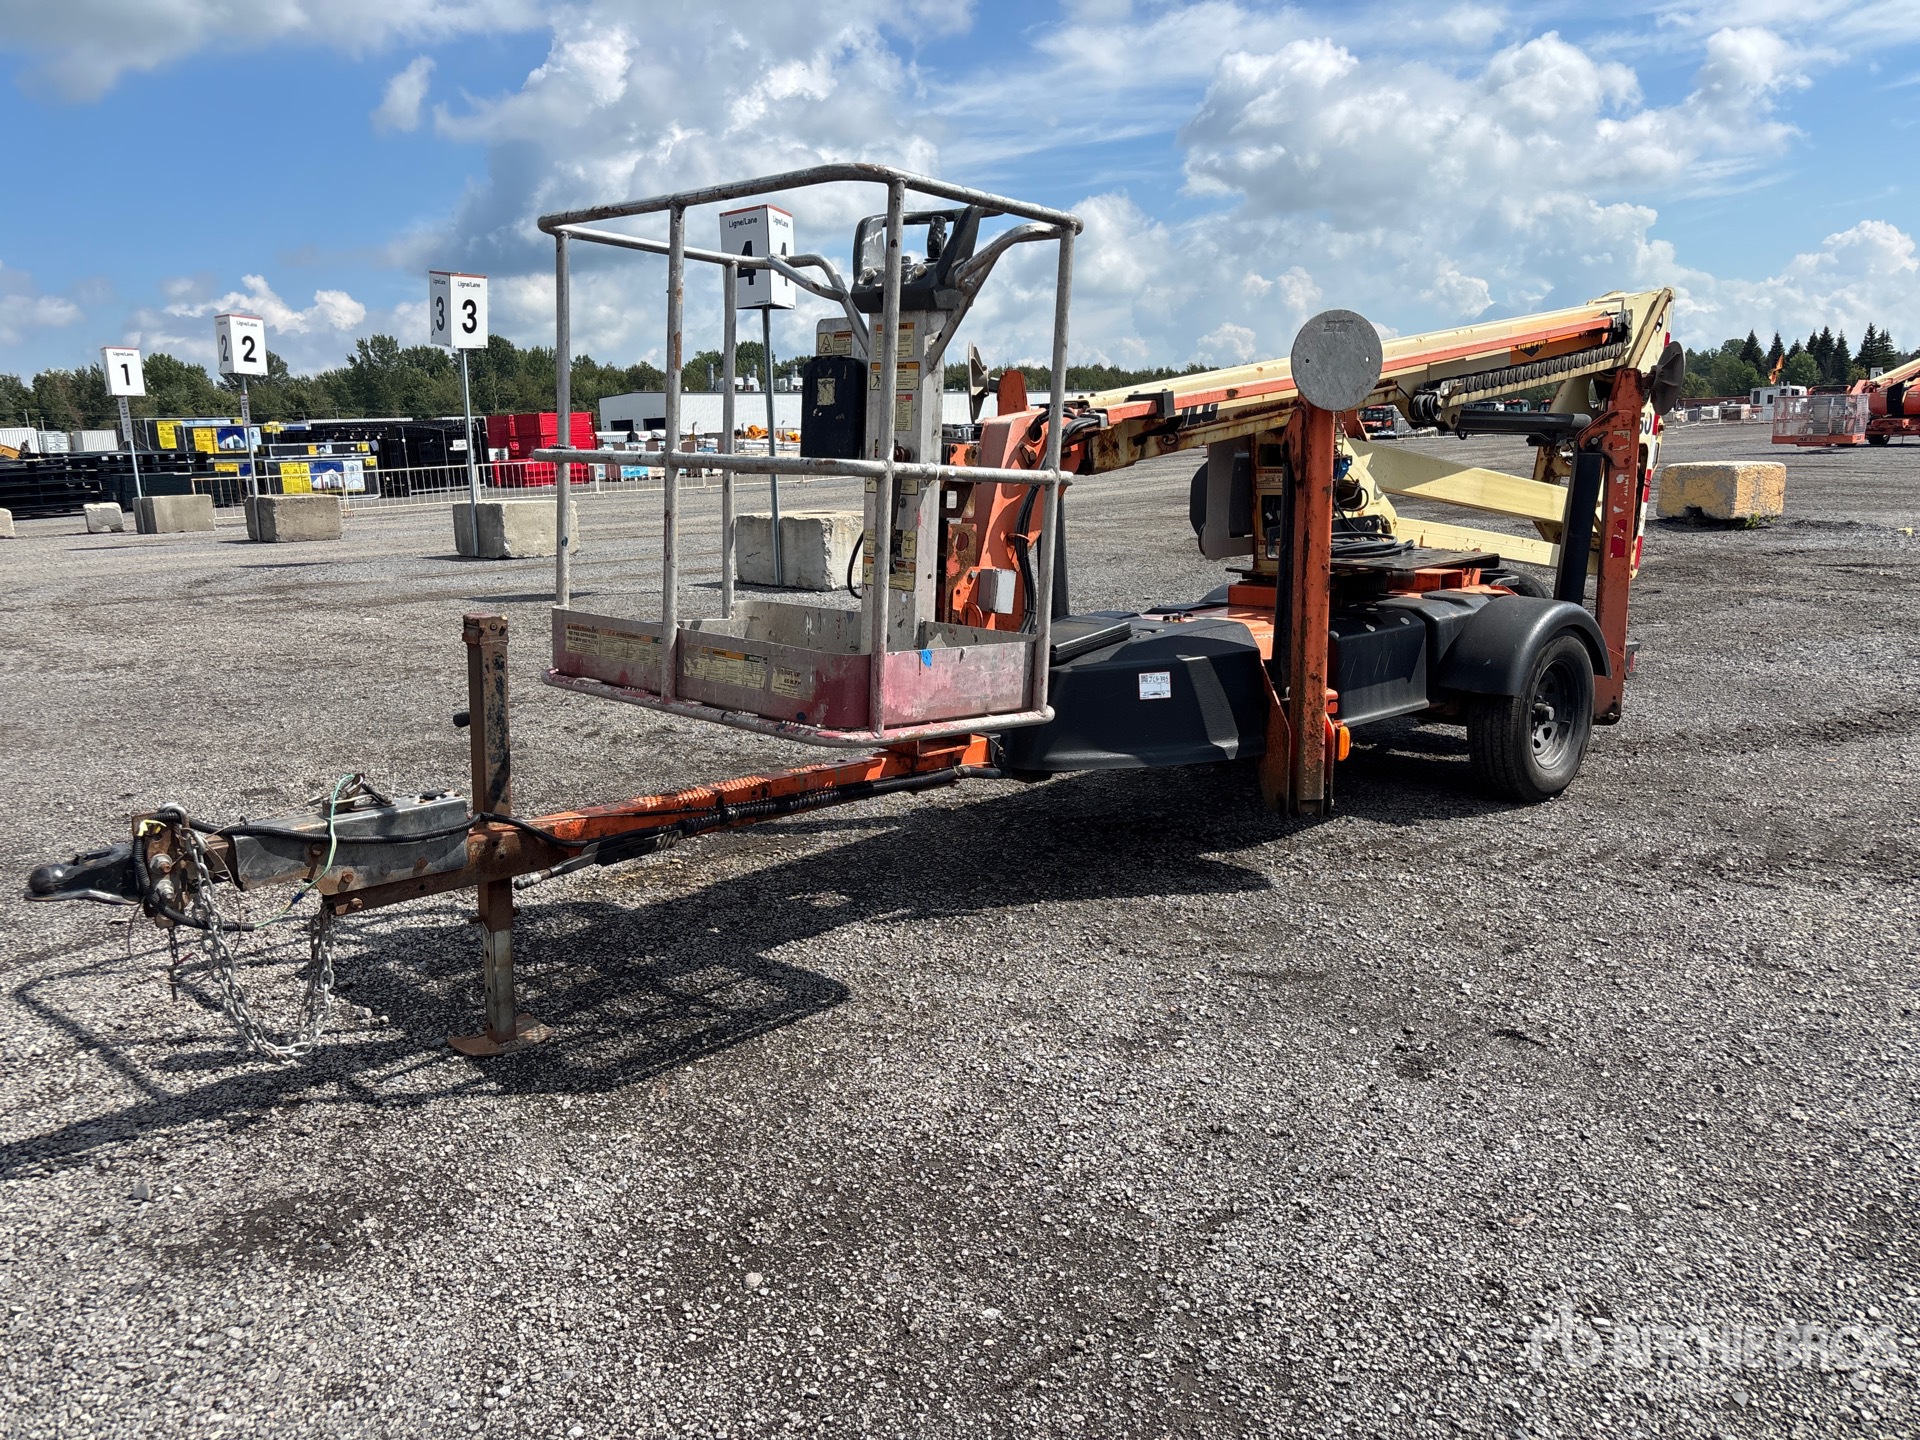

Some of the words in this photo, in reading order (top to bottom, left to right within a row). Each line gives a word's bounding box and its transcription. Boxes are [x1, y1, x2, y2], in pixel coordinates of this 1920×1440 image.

[728, 217, 757, 229] Ligne/Lane
[737, 240, 756, 286] 4
[436, 296, 445, 332] 3
[462, 299, 477, 334] 3
[221, 334, 229, 362] 2
[241, 335, 257, 363] 2
[121, 364, 130, 386] 1
